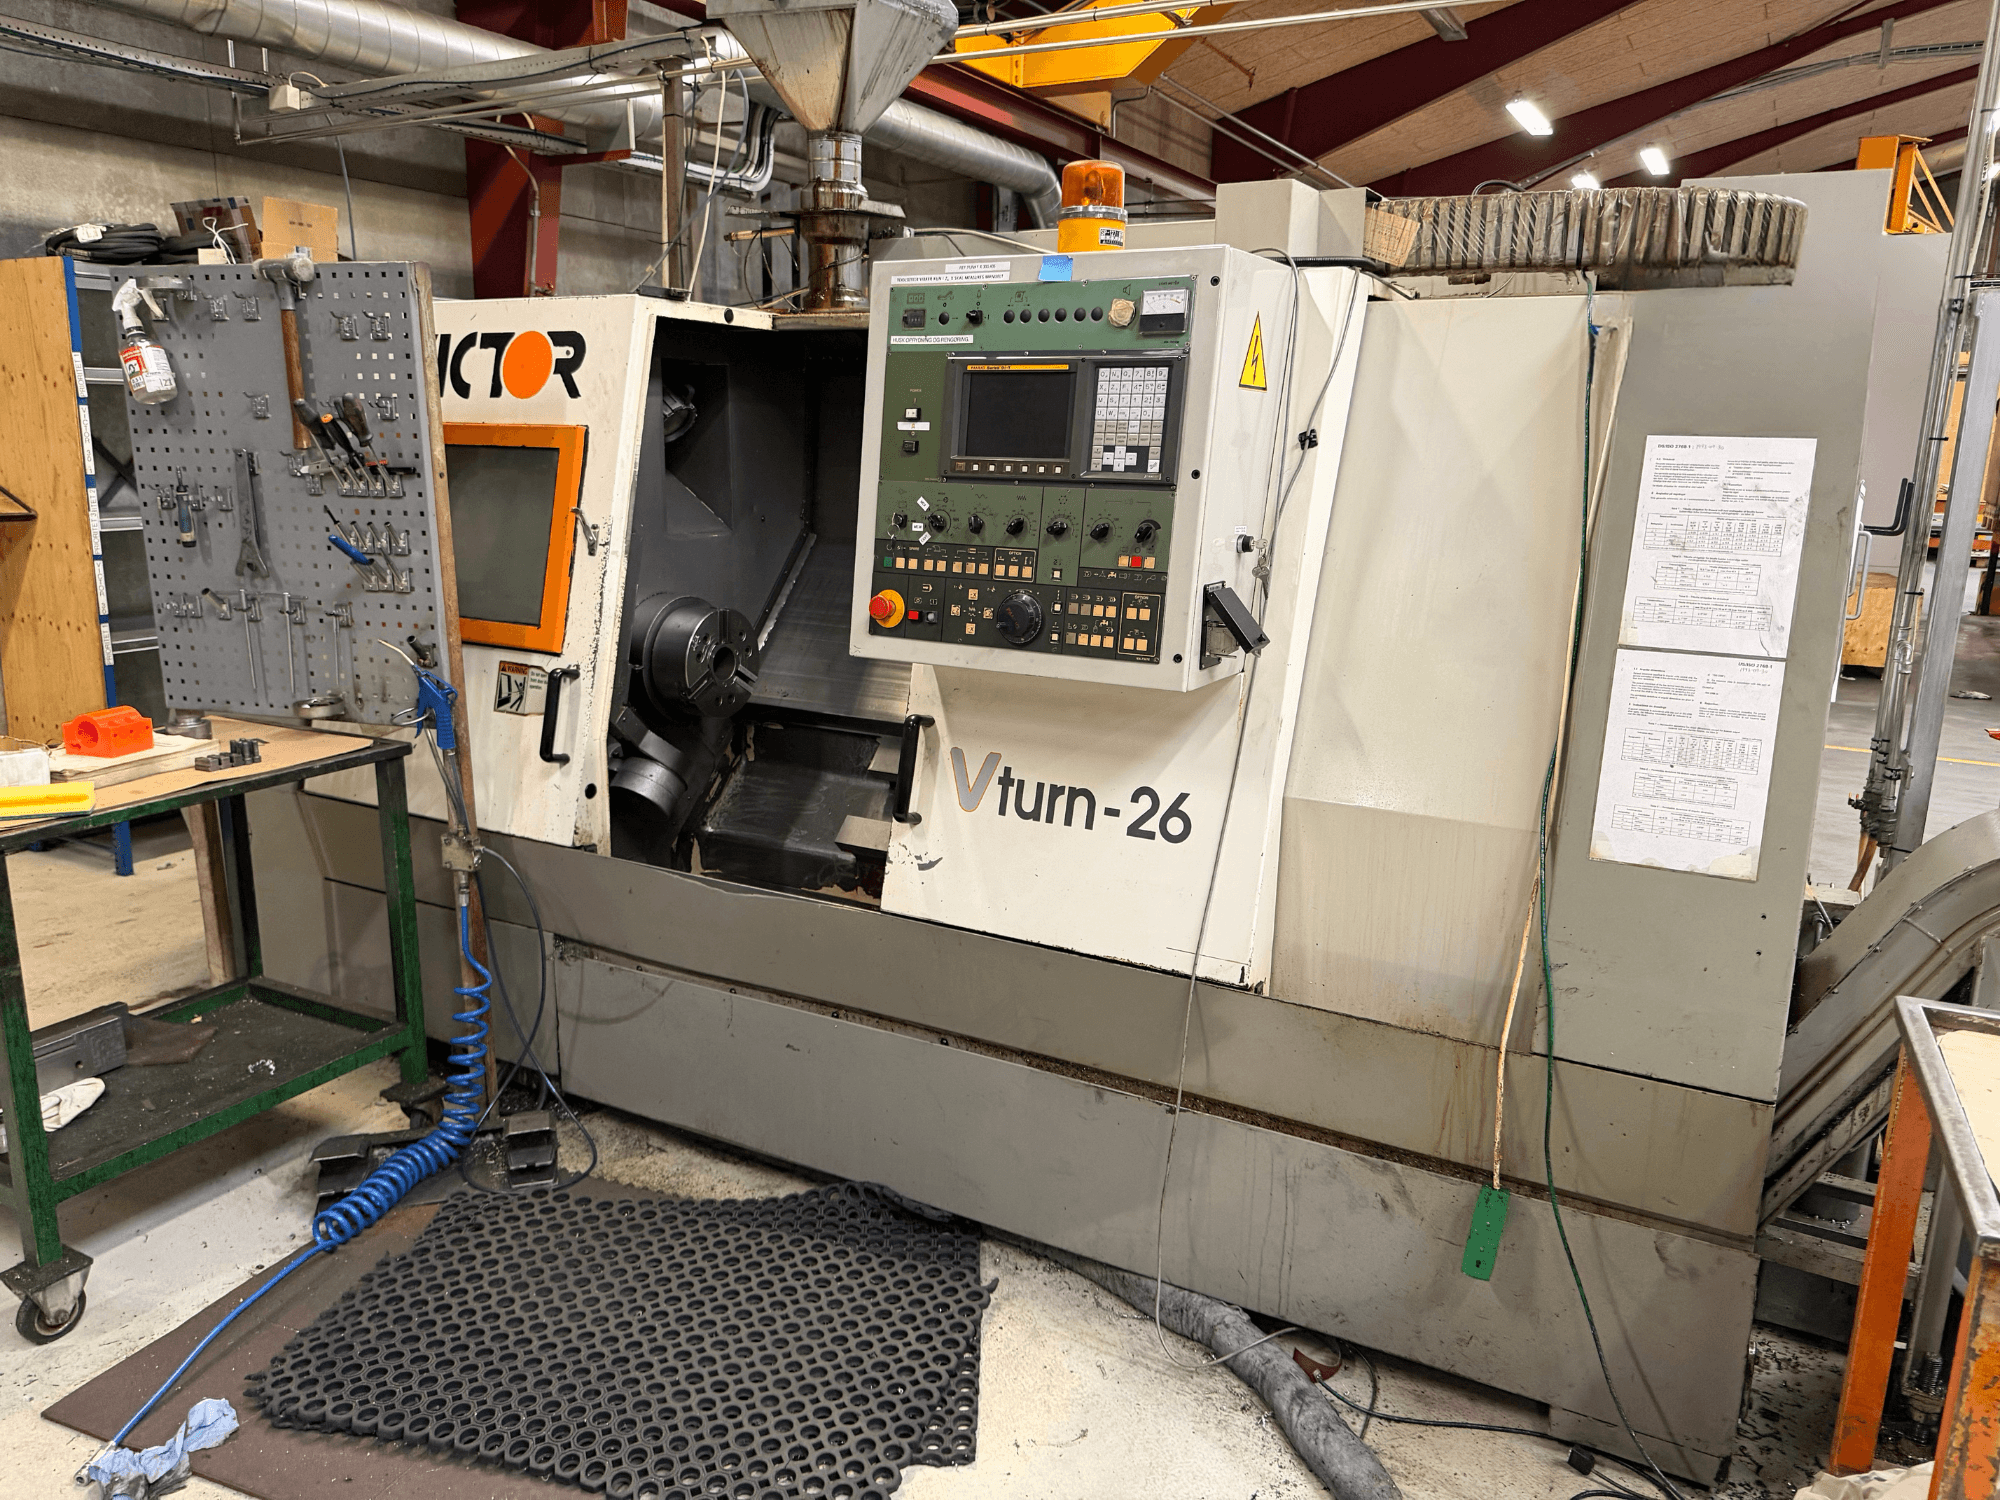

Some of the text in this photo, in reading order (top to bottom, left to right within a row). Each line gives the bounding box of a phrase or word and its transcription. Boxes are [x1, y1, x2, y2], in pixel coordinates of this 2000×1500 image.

[435, 331, 586, 400] ICTOR
[81, 407, 90, 444] VICTOR
[96, 562, 104, 596] VICTOR
[507, 665, 528, 675] WARNING
